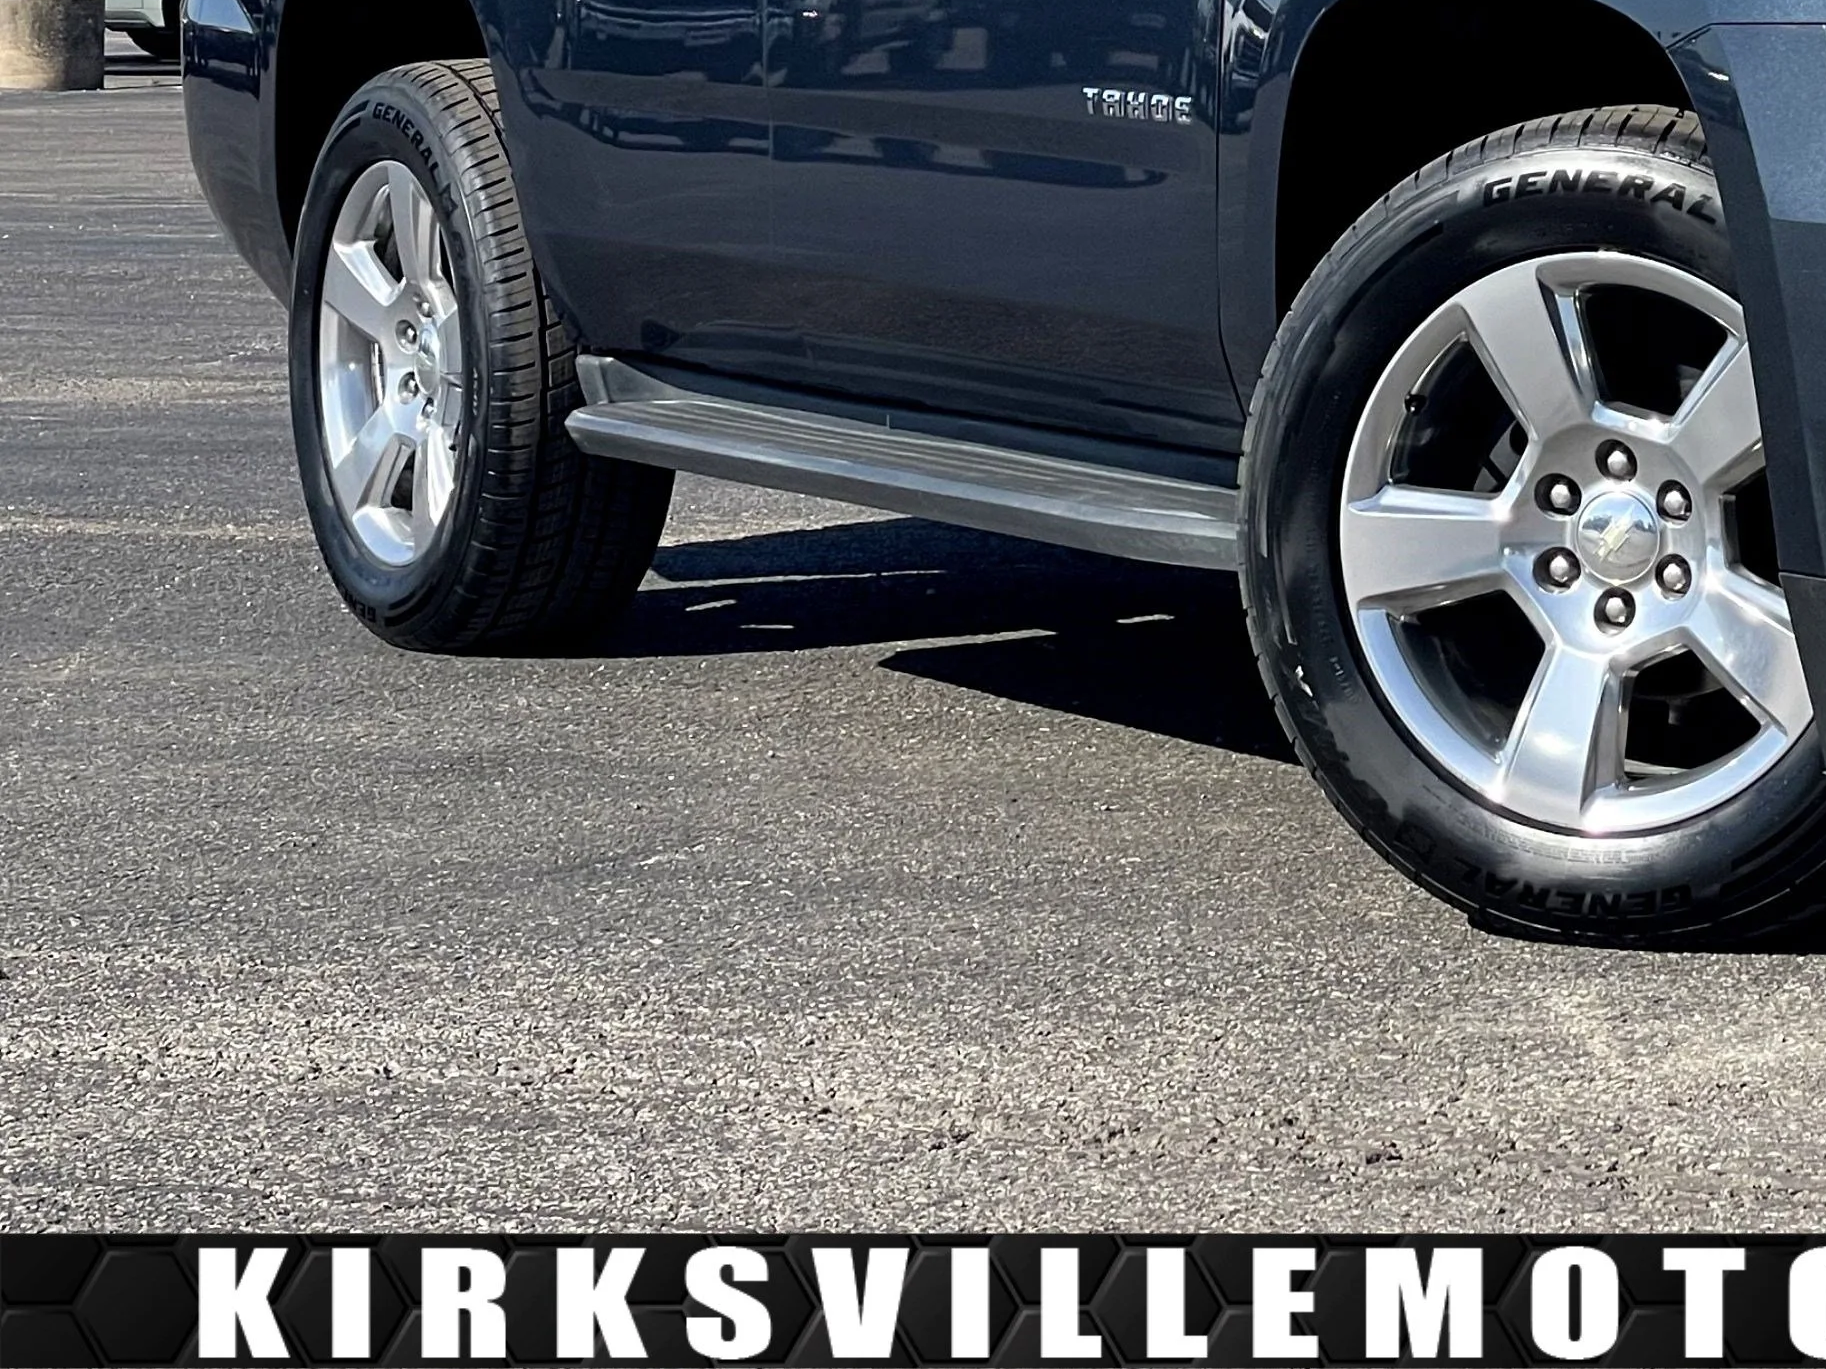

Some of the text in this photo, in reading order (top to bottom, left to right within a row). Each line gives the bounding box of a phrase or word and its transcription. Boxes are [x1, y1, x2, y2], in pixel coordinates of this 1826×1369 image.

[1082, 87, 1193, 125] TAHOE
[372, 101, 440, 190] GENERAL
[1483, 168, 1717, 225] GENERAL
